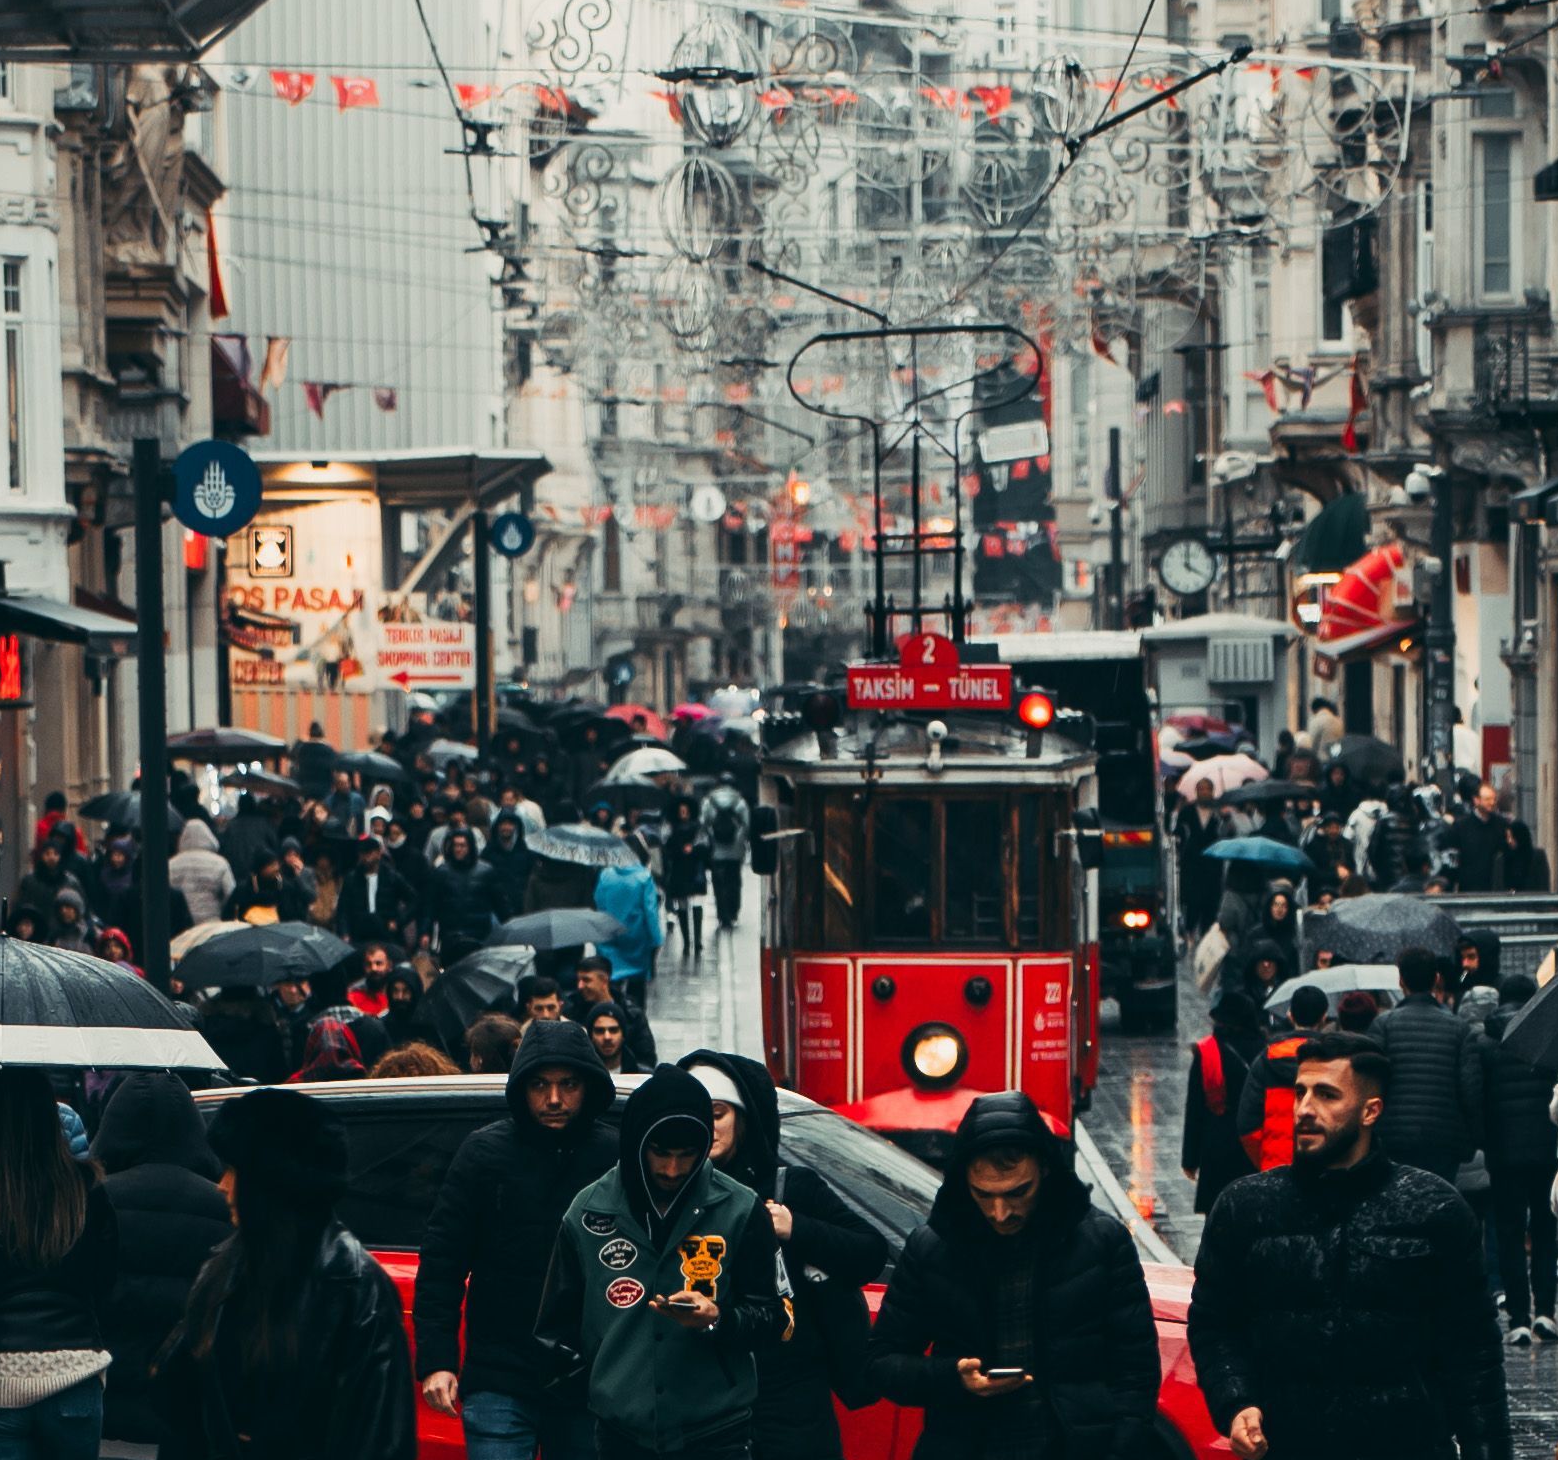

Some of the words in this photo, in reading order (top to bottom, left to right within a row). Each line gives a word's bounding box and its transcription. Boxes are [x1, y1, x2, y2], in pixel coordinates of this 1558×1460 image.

[922, 636, 936, 664] 2
[853, 672, 915, 700] TAKSİM
[948, 672, 1003, 700] TÜNEL
